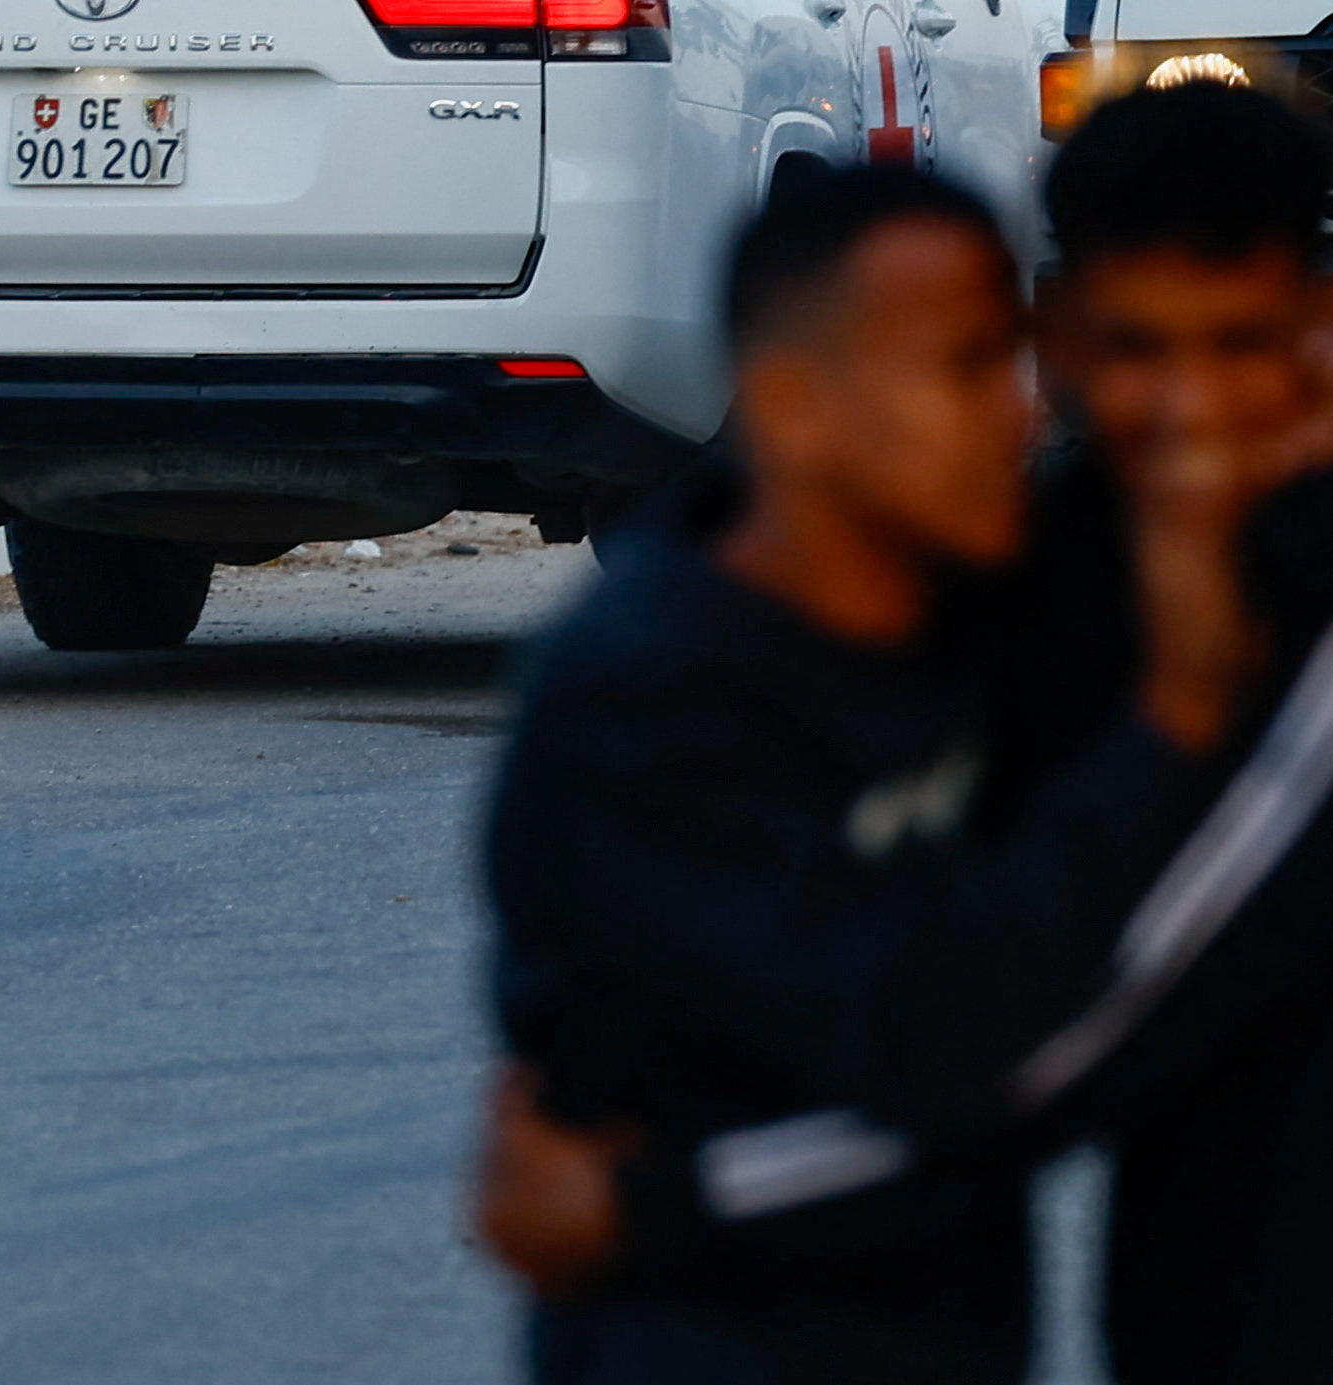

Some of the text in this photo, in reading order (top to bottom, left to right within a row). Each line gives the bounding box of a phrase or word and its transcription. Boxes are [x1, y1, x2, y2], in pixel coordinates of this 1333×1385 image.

[68, 32, 277, 53] CRUISER
[78, 98, 122, 131] GE
[16, 138, 180, 180] 901 207
